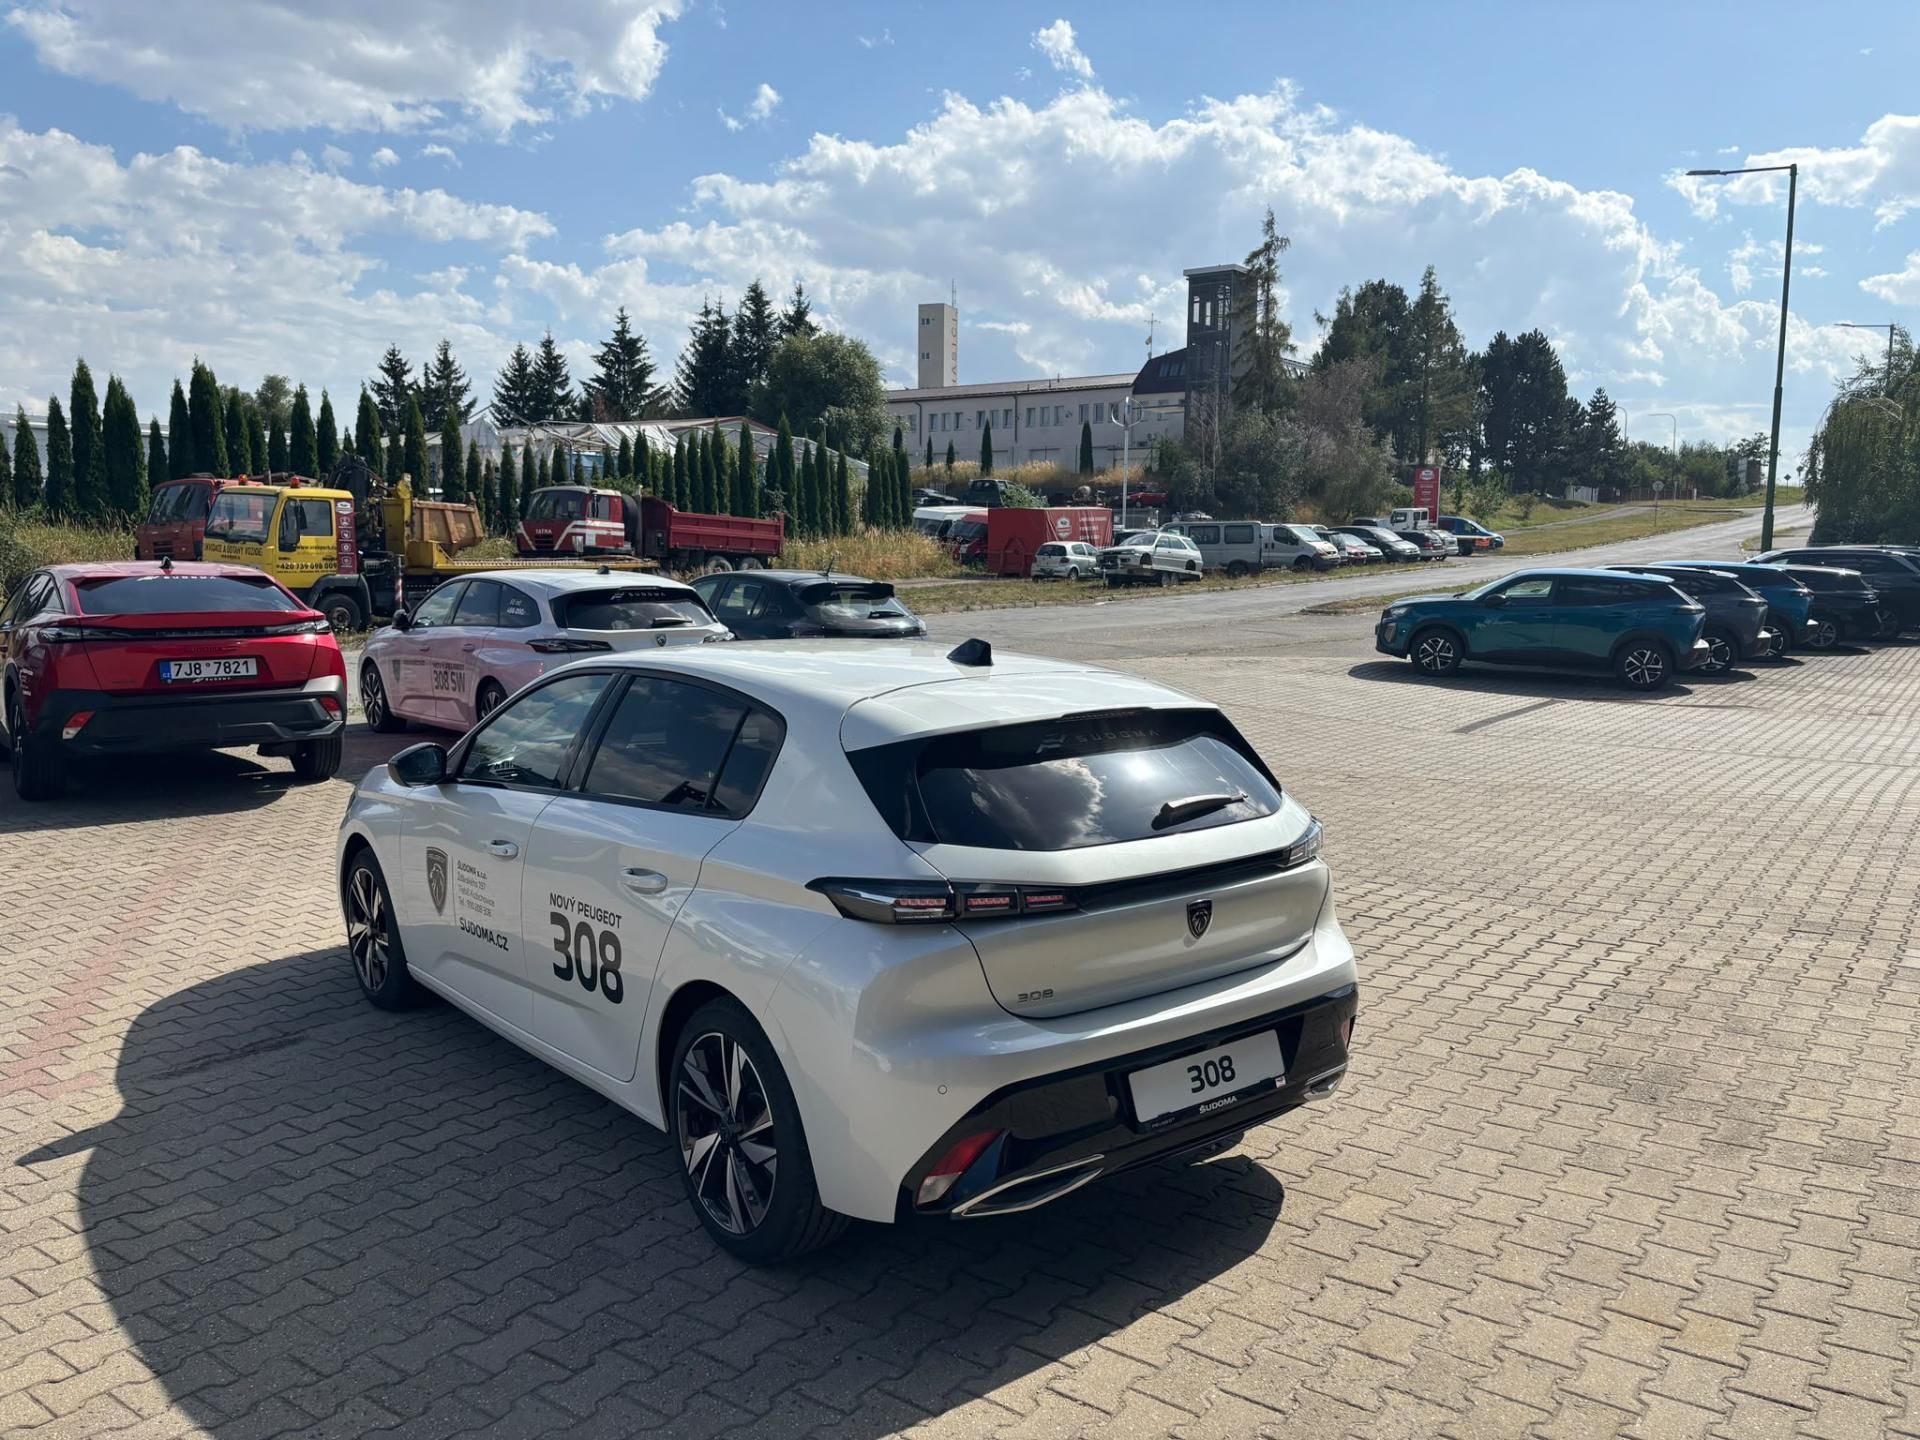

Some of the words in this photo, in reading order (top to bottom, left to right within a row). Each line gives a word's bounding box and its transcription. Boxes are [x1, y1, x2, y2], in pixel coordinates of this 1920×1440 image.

[173, 662, 202, 677] 7J8
[213, 660, 249, 675] 7821
[433, 669, 450, 690] 308
[450, 671, 466, 693] SW
[549, 891, 576, 912] NOVÝ
[577, 901, 622, 929] PEUGEOT
[549, 911, 624, 1005] 308
[1017, 988, 1054, 1003] 308
[1186, 1054, 1236, 1094] 308
